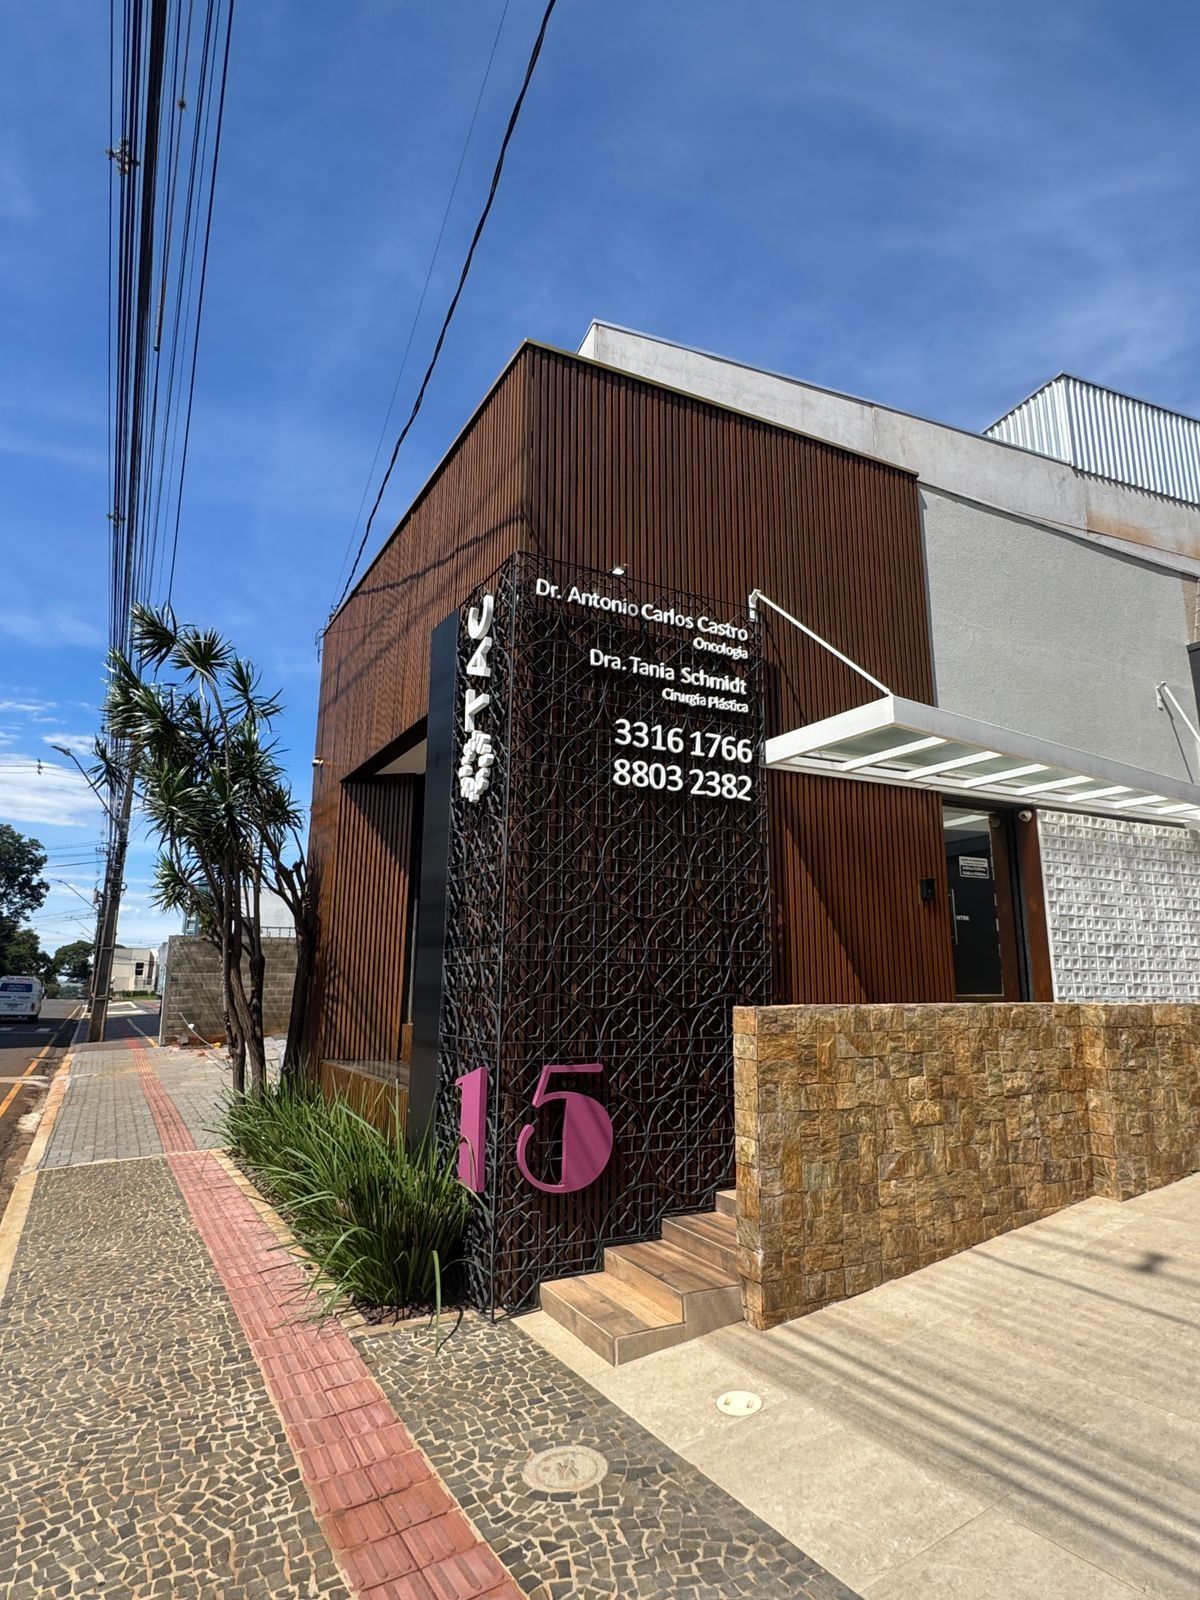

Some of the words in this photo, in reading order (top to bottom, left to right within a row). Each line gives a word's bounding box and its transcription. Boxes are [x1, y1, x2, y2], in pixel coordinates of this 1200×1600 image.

[536, 578, 561, 599] Dr.
[567, 586, 639, 617] Antonio
[641, 604, 694, 629] Carlos
[697, 616, 749, 641] Castro
[590, 649, 627, 671] Dra.
[629, 656, 675, 680] Tania
[680, 667, 747, 695] Schmidt
[707, 696, 749, 713] Plástica
[614, 718, 684, 753] 3316
[689, 731, 753, 763] 1766
[612, 759, 684, 791] 8803
[688, 769, 752, 801] 2382
[455, 1063, 613, 1193] 15
